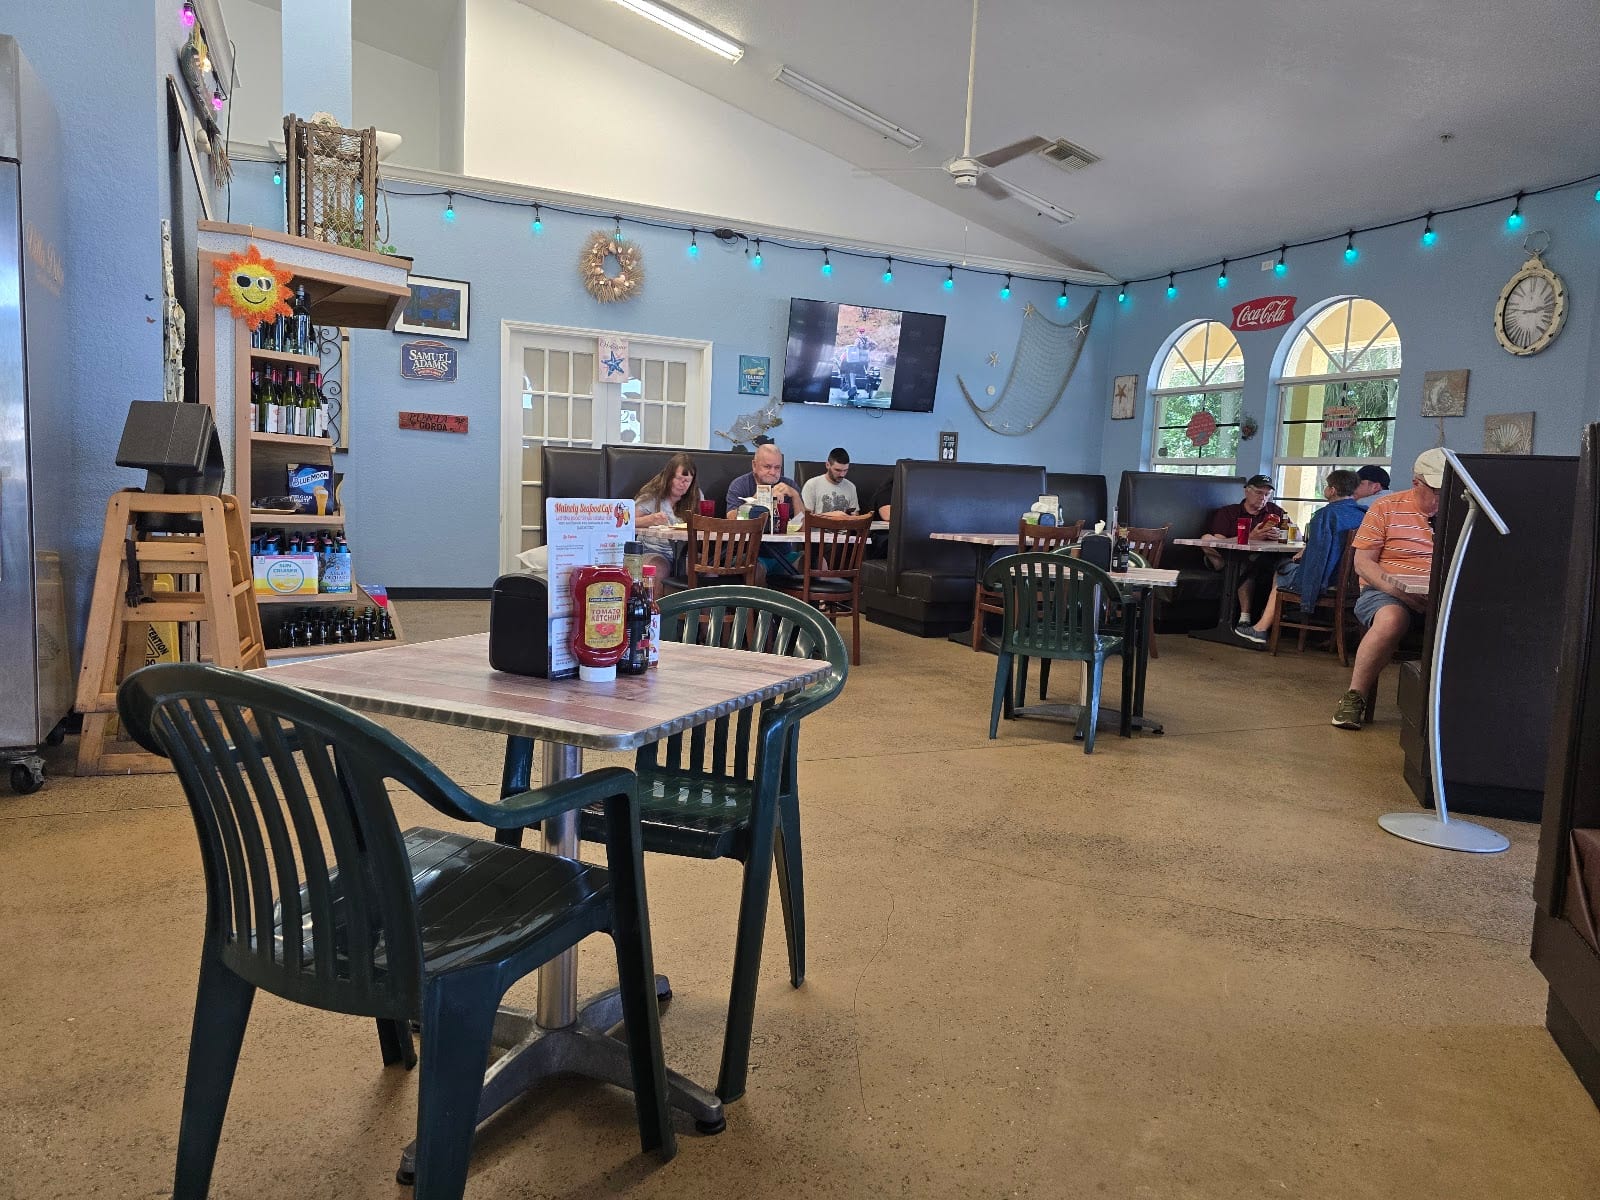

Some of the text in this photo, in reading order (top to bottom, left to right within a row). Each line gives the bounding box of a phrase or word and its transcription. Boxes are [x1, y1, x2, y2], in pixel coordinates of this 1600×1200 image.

[1236, 299, 1290, 328] Coca-Cola
[408, 350, 452, 364] SAMUEL
[412, 360, 448, 372] ADAMS
[419, 421, 448, 432] GORDA
[591, 608, 621, 616] TOMATO
[591, 614, 621, 623] KETCHUP
[148, 623, 169, 655] TENTION
